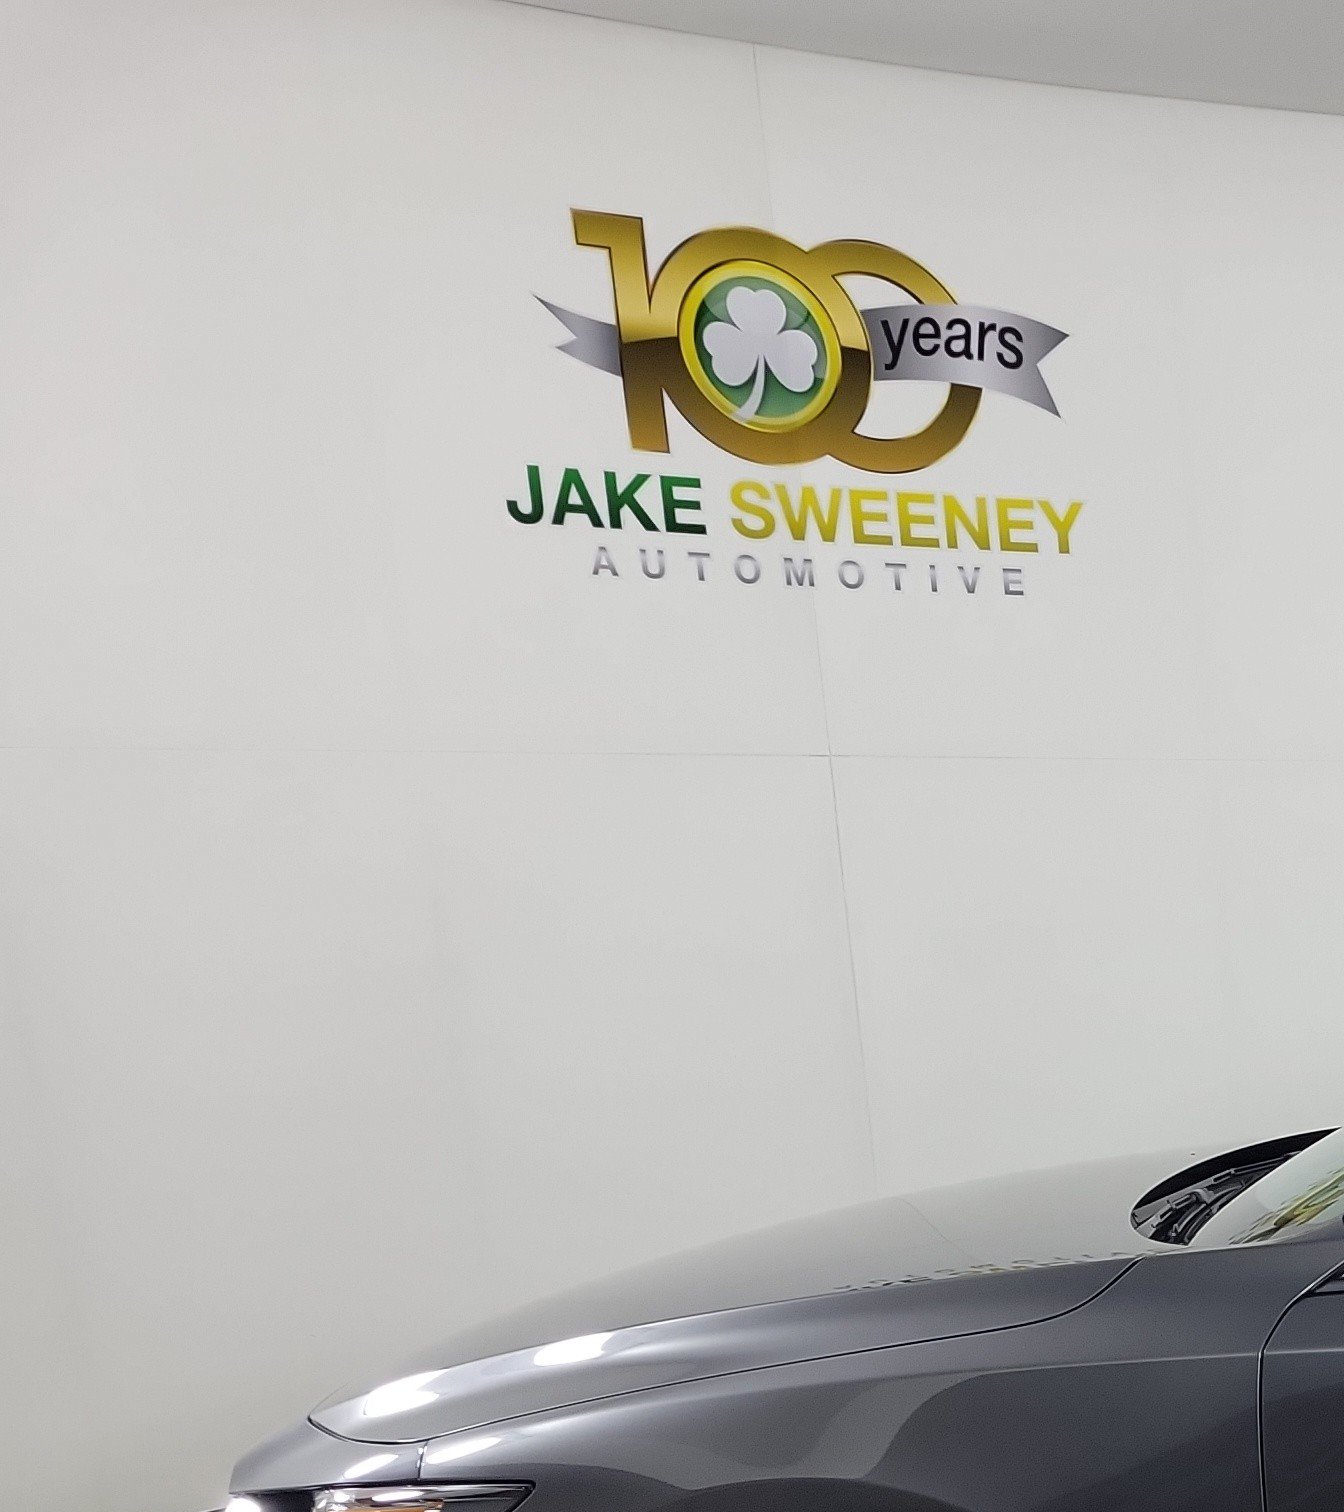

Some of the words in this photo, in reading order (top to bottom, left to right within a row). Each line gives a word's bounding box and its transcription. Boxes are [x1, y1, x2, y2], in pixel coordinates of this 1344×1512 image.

[881, 315, 1025, 371] years
[506, 464, 708, 536] JAKE
[730, 481, 1084, 555] SWEENEY
[591, 546, 1025, 596] AUTOMOTIVE
